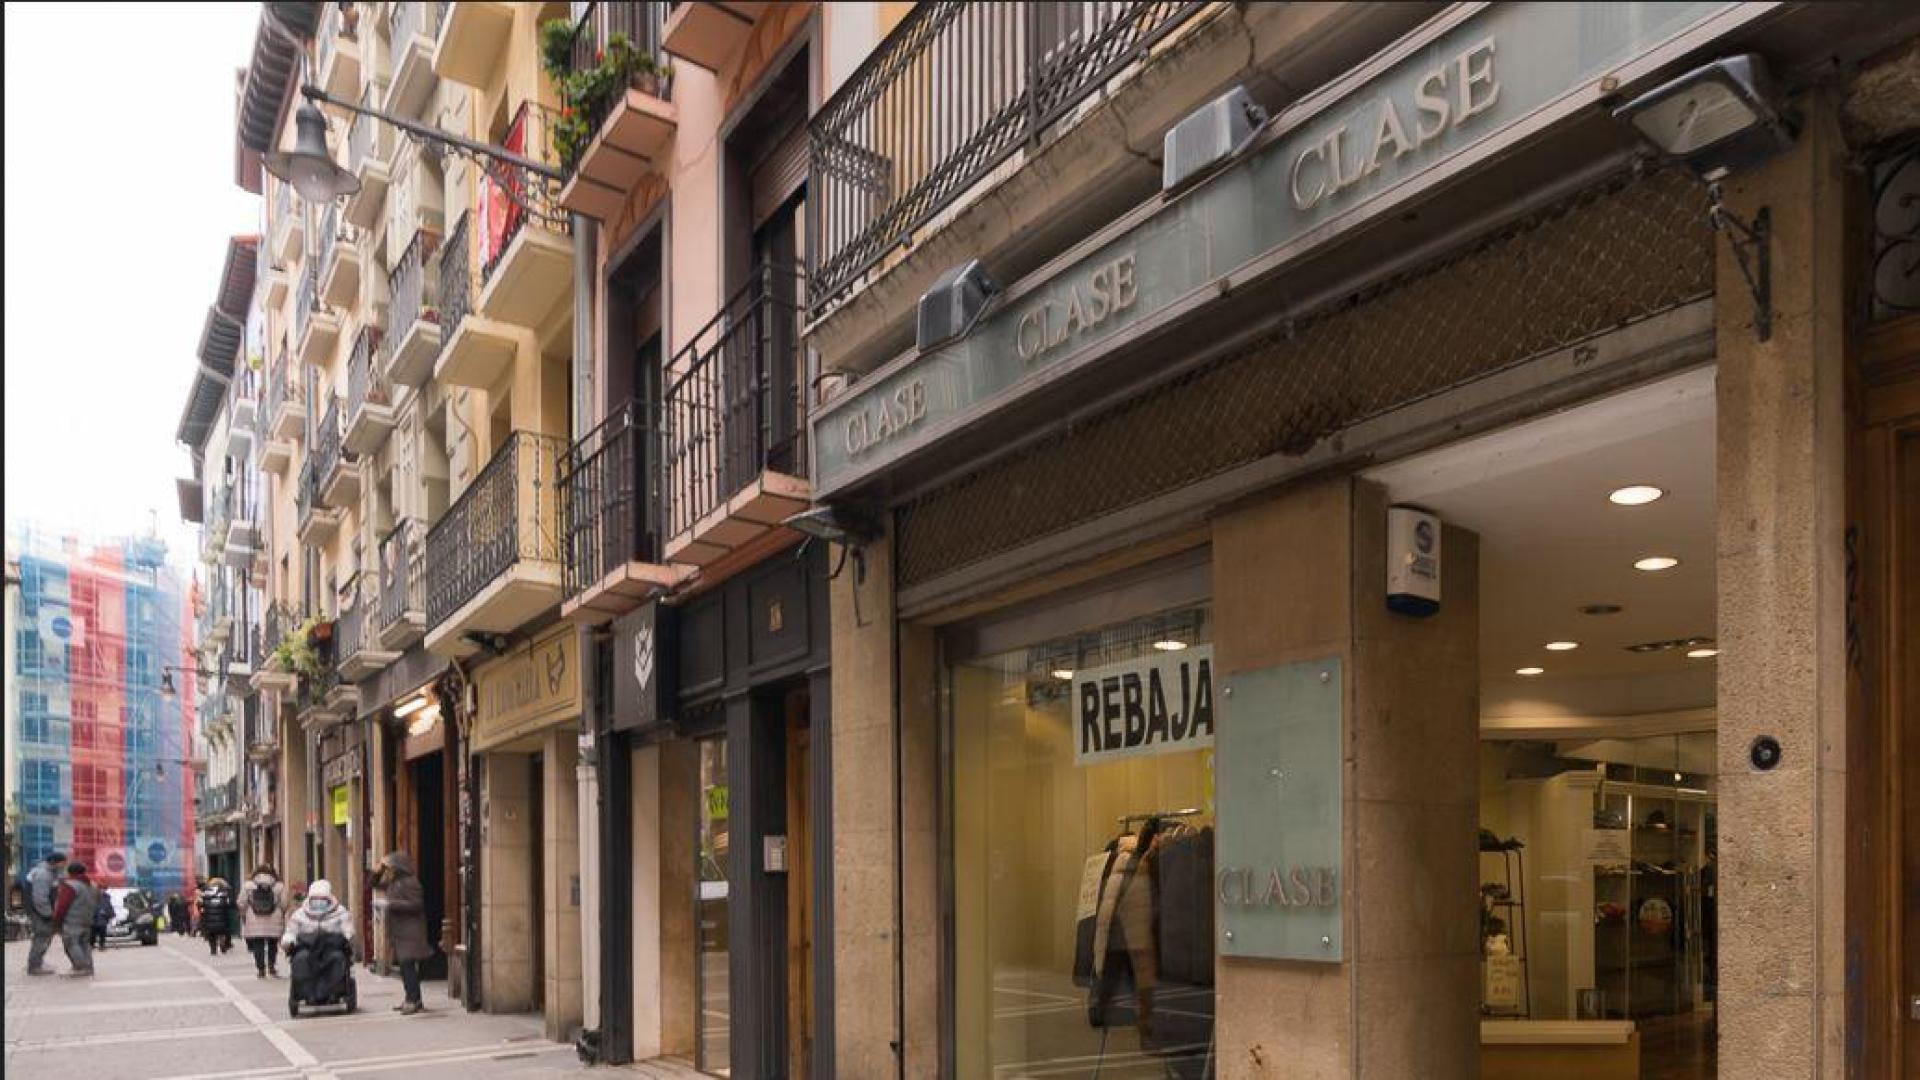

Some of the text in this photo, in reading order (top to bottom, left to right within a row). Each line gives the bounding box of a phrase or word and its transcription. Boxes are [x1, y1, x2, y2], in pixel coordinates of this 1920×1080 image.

[1291, 35, 1501, 211] CLASE
[1017, 253, 1138, 361] CLASE
[847, 378, 929, 456] CLASE
[1080, 658, 1214, 754] REBAJA
[1217, 865, 1336, 908] CLASE
